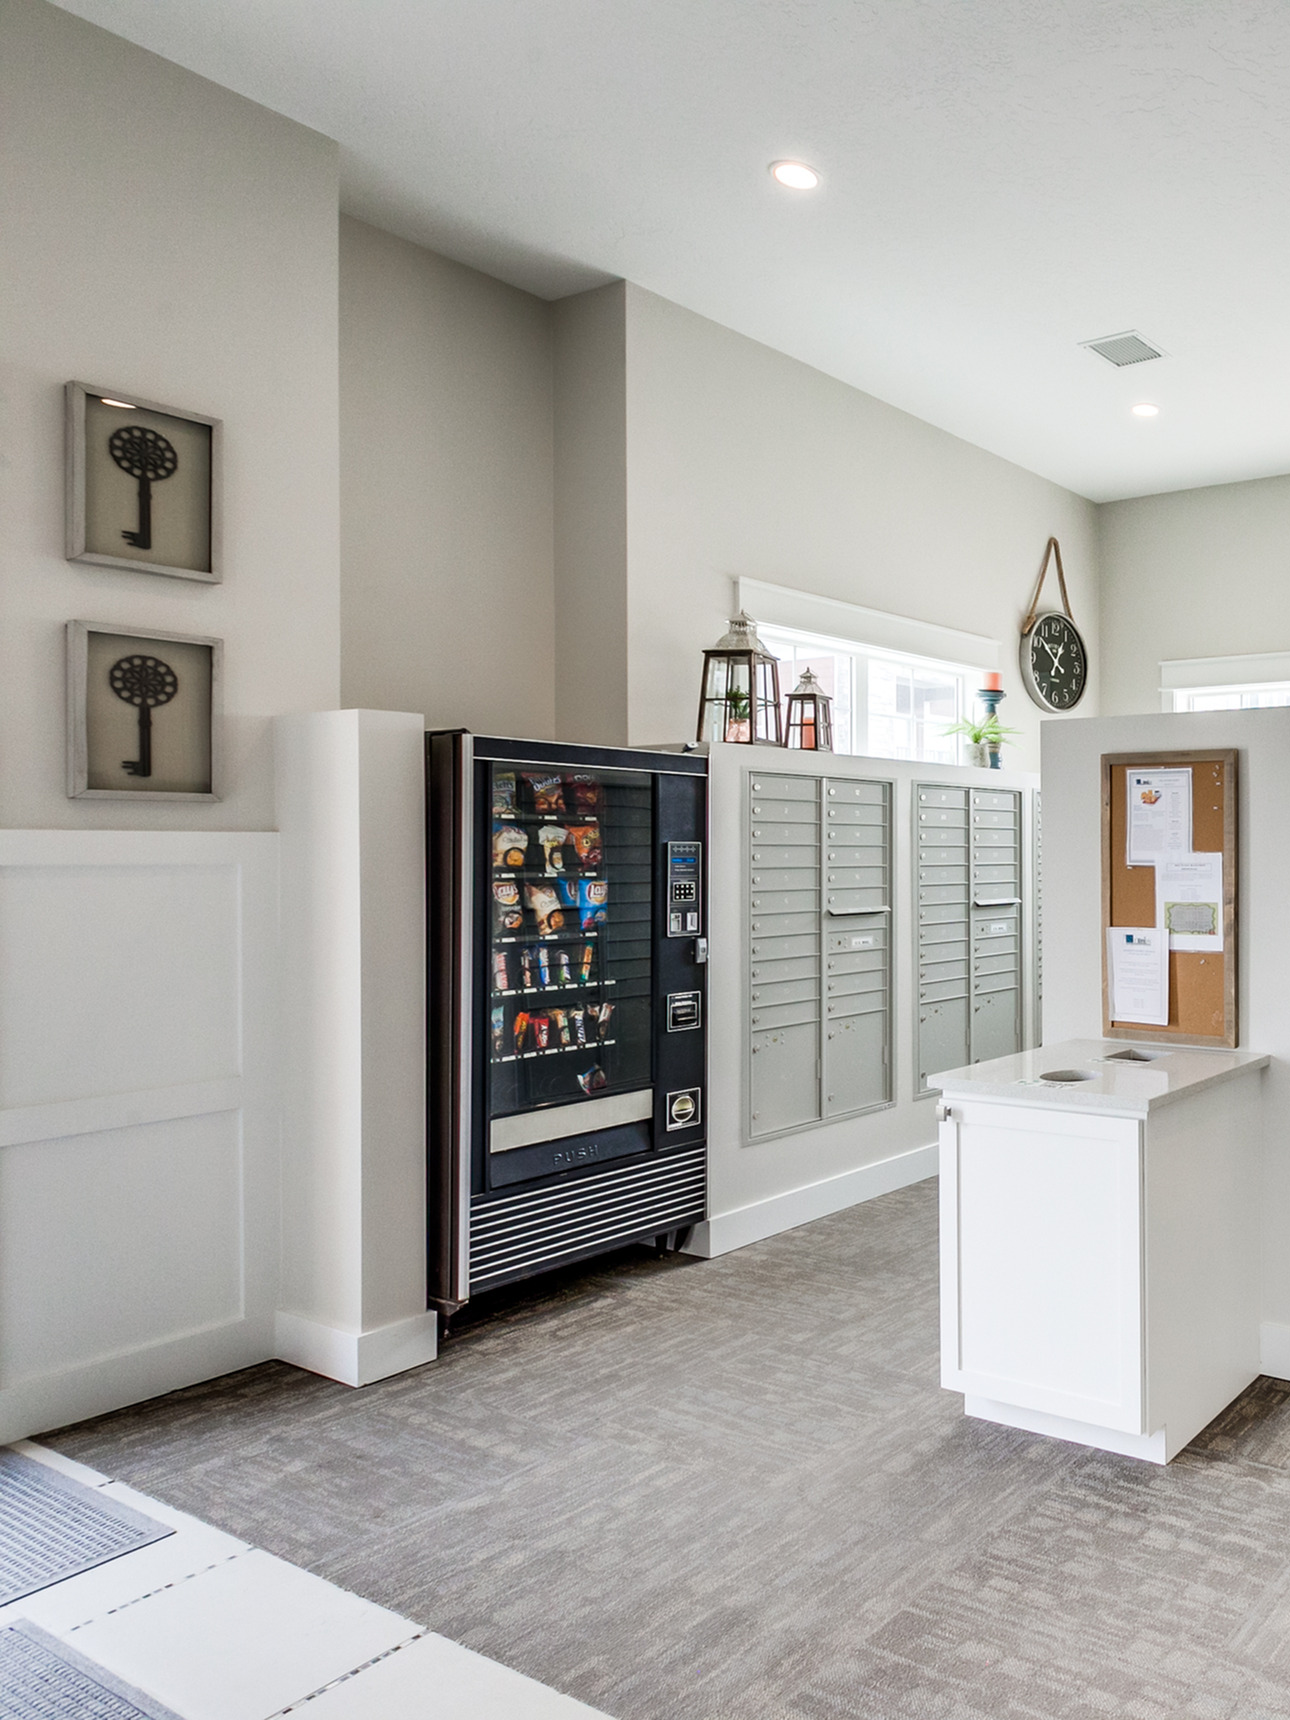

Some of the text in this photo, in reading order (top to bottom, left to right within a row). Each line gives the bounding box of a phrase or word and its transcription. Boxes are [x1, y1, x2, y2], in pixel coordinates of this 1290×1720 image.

[1042, 623, 1048, 638] 11
[1052, 622, 1060, 636] 12
[1034, 635, 1042, 648] 10
[1064, 630, 1068, 642] 1
[1070, 644, 1077, 657] 2
[1073, 661, 1080, 674] 3
[1033, 670, 1040, 683] 8
[1041, 683, 1048, 696] 7
[1070, 679, 1076, 690] 4
[1052, 691, 1059, 704] 6
[1063, 689, 1069, 702] 5
[553, 1143, 599, 1165] PUSH
